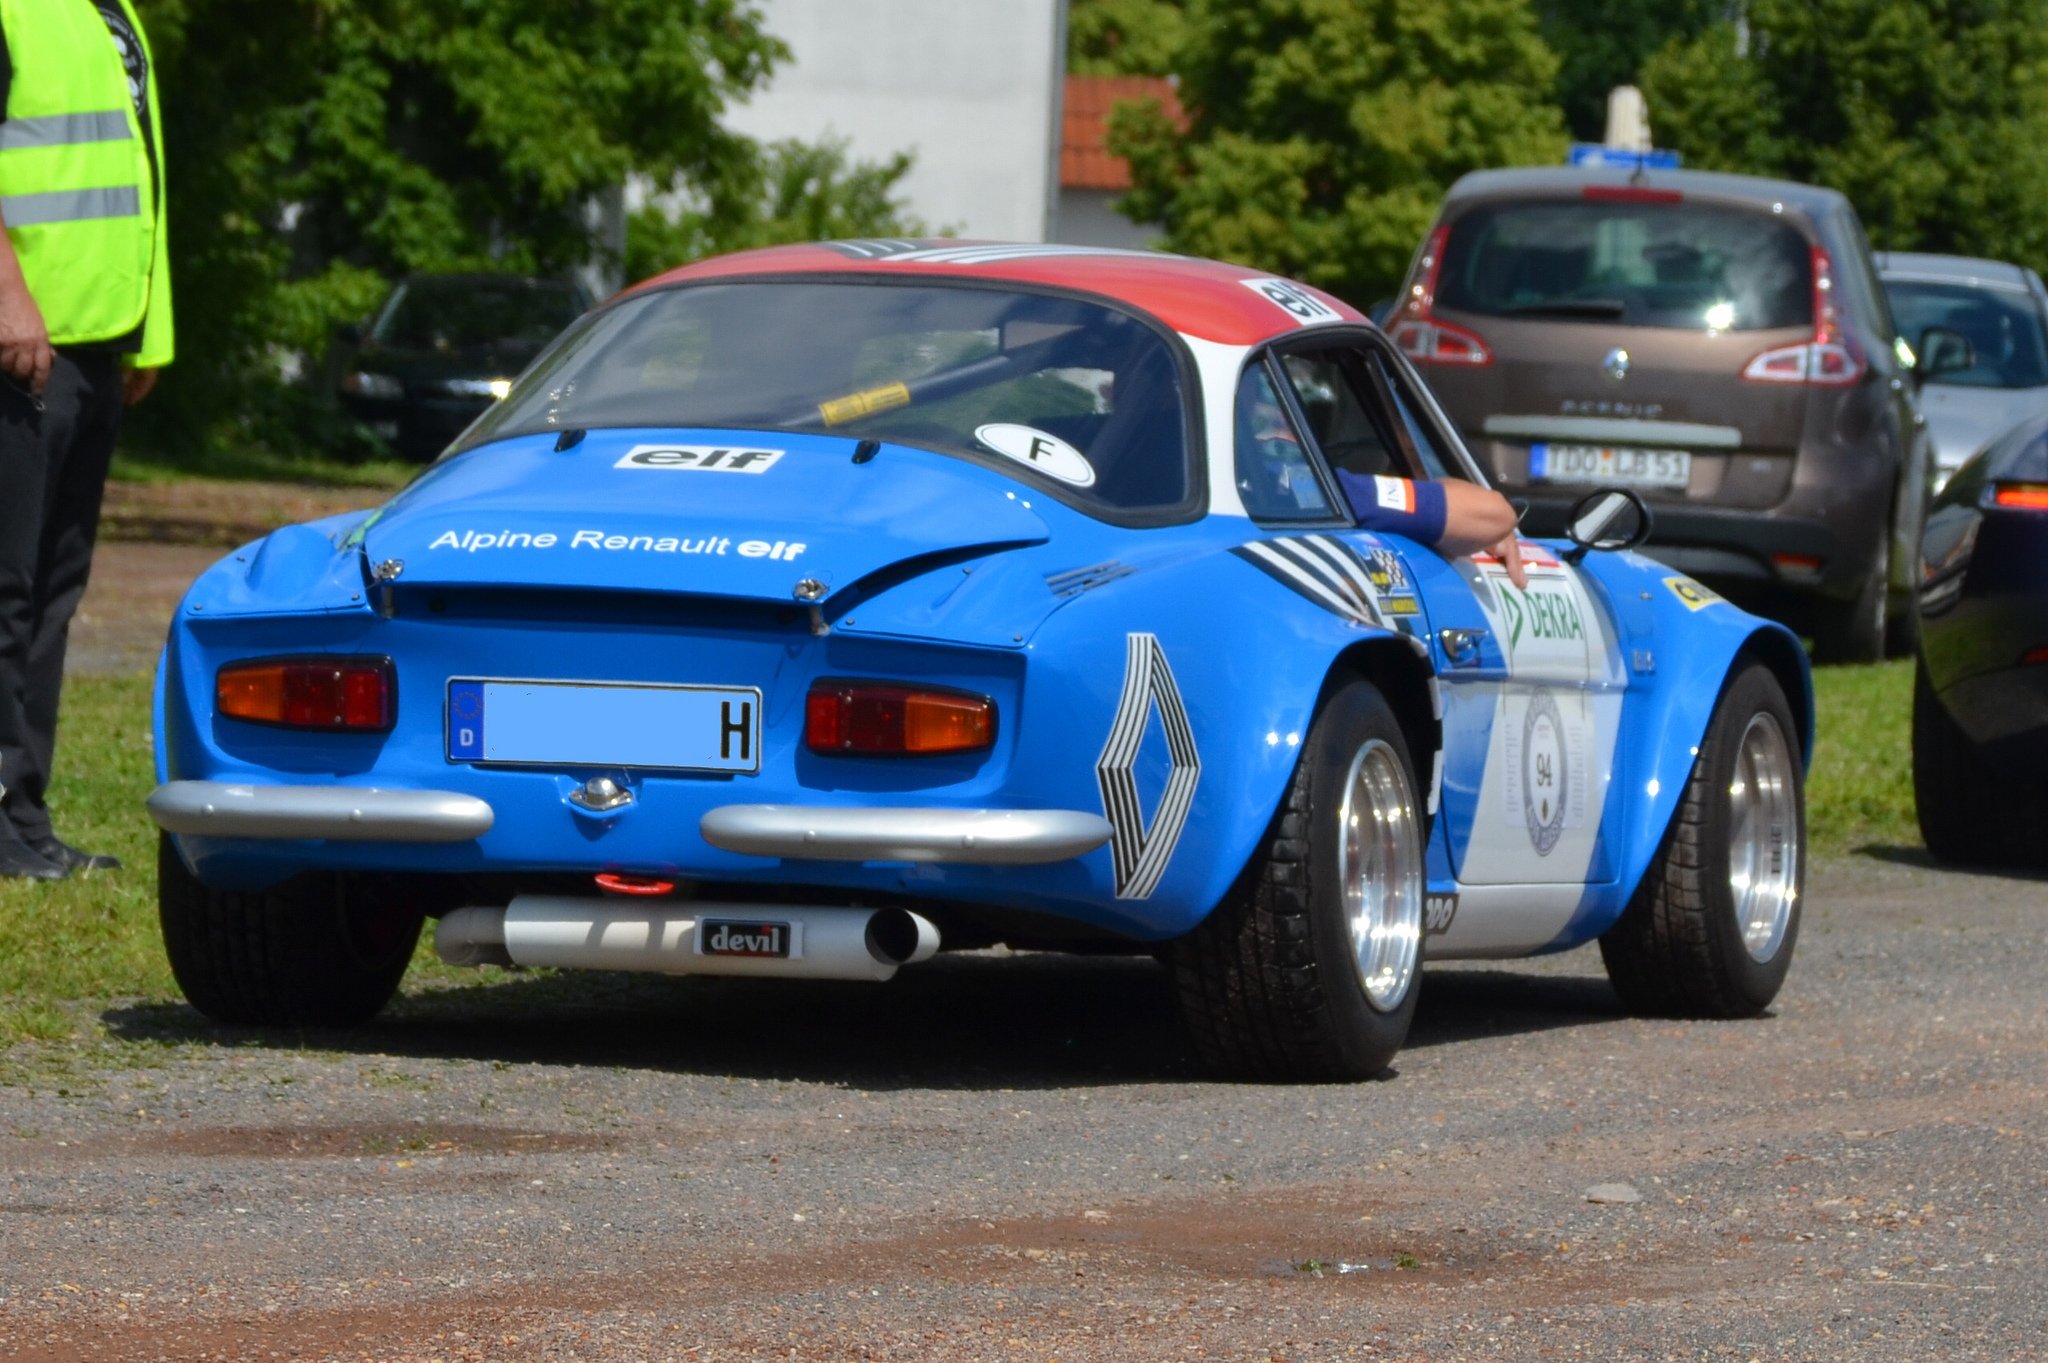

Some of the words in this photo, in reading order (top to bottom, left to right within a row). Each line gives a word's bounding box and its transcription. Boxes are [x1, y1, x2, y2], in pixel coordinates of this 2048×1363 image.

[1260, 281, 1331, 317] elf
[631, 450, 773, 469] elf
[1029, 436, 1055, 461] F
[428, 530, 558, 553] Alpine
[570, 530, 731, 556] Renault
[737, 540, 807, 561] elf
[1522, 591, 1583, 640] DEKRA
[460, 728, 473, 746] D
[721, 701, 751, 760] H
[1537, 753, 1552, 787] 94
[711, 924, 780, 953] devil
